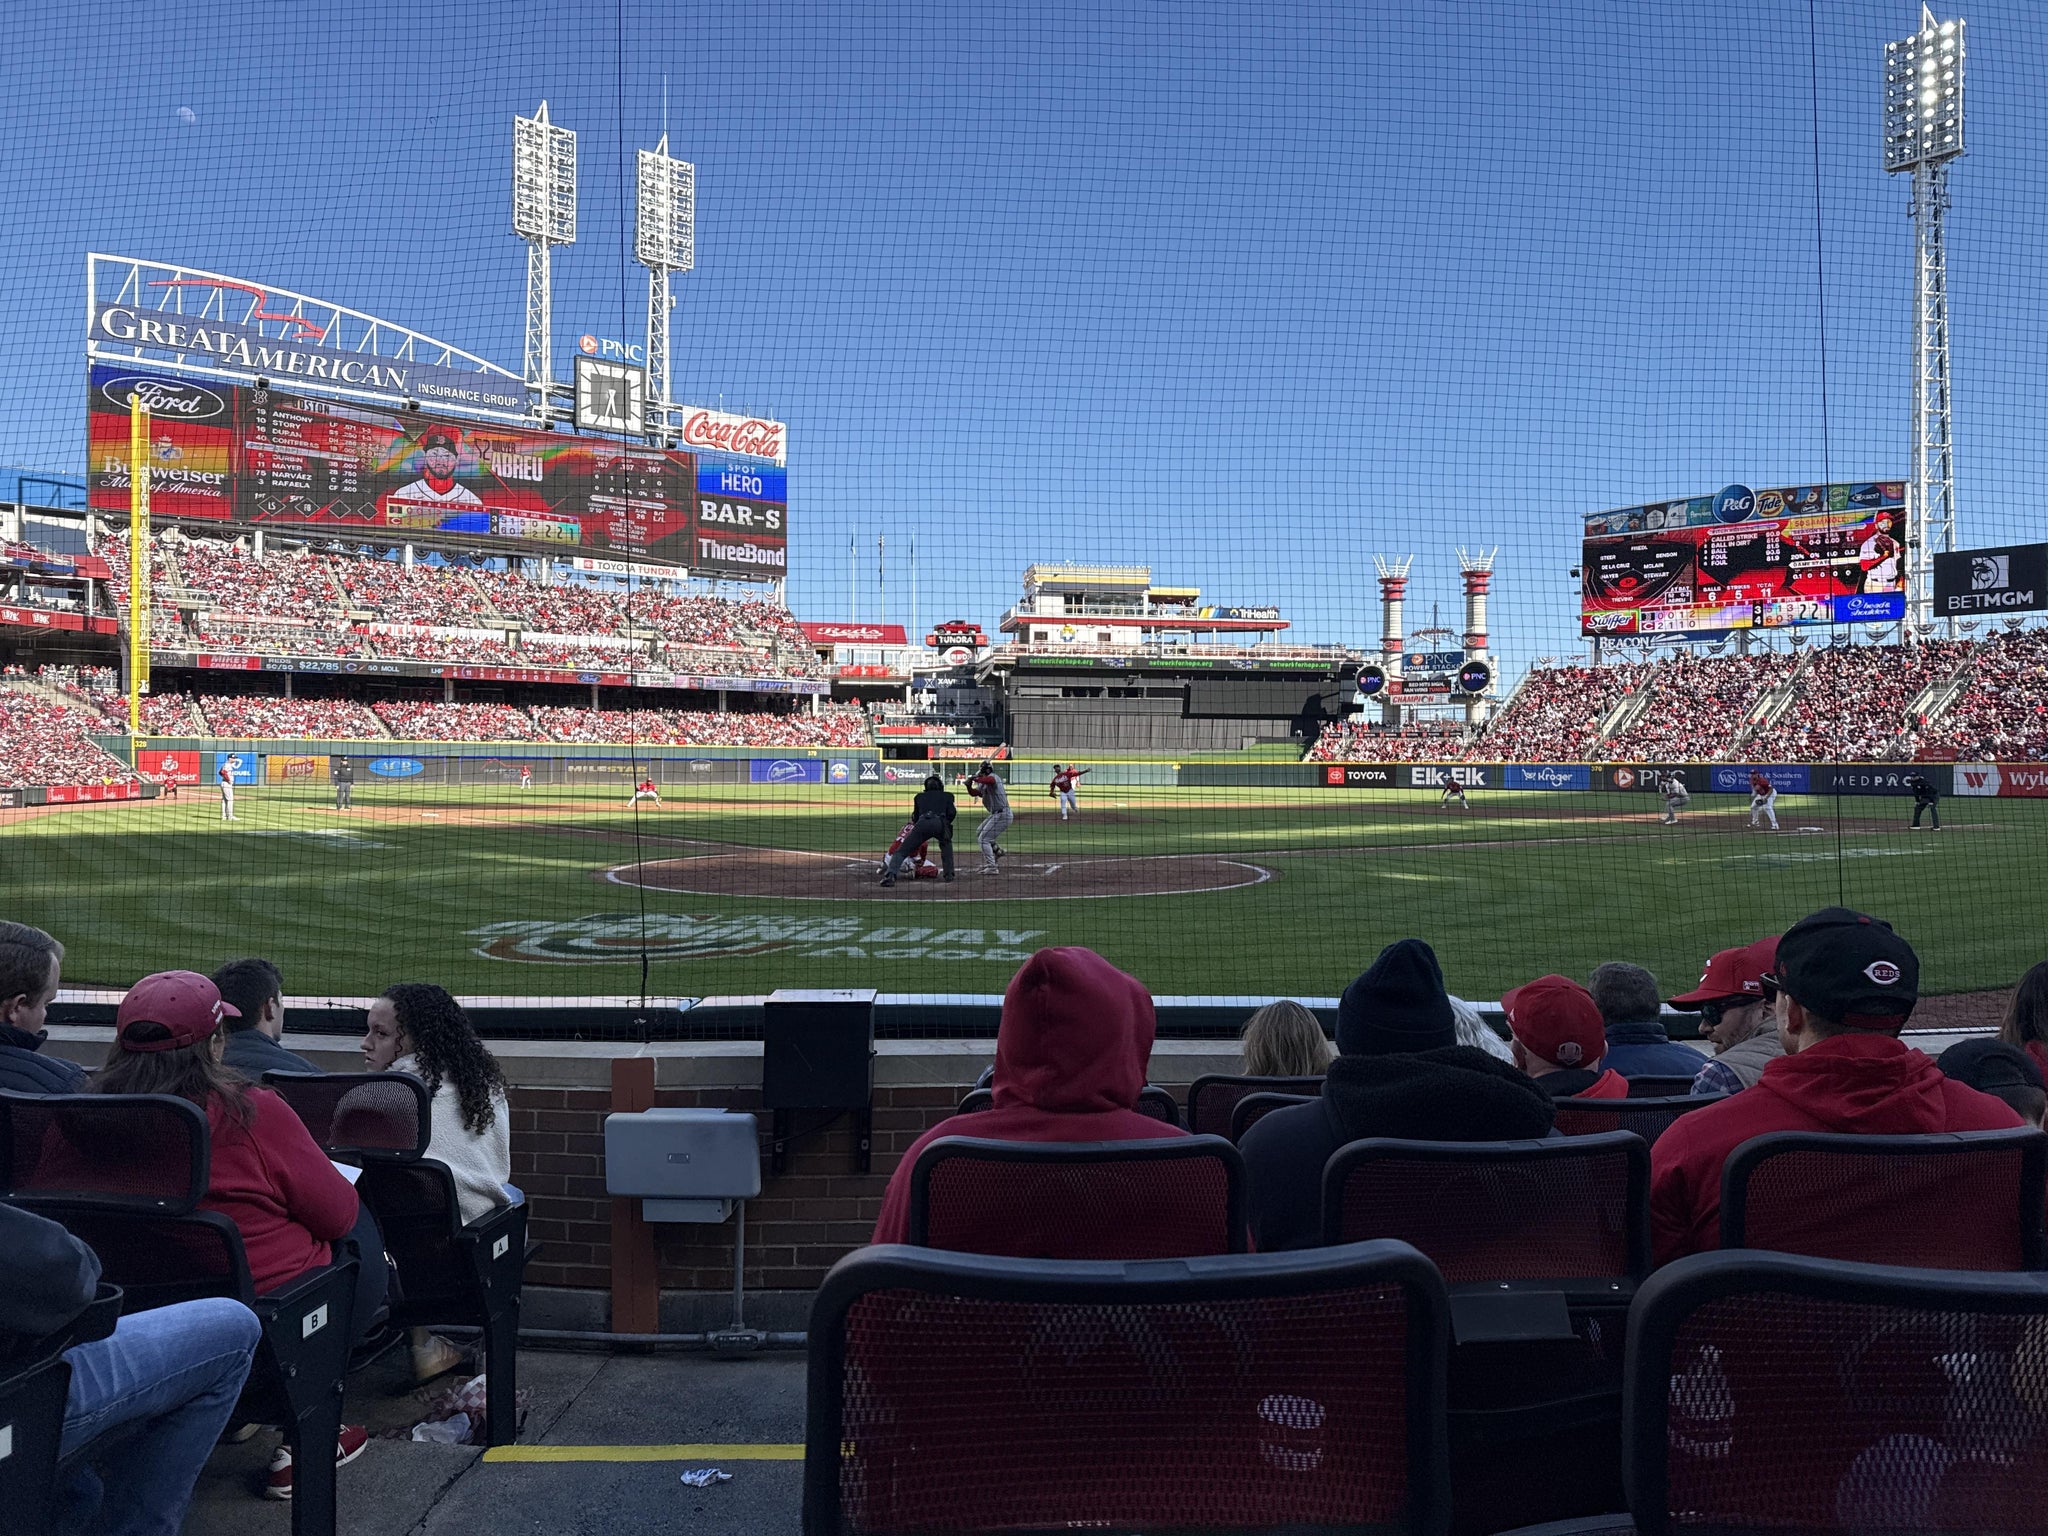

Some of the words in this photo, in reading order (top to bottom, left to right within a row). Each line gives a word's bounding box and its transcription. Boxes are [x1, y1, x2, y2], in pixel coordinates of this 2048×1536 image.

[600, 338, 643, 362] PNC
[126, 381, 202, 414] Ford
[417, 382, 480, 402] INSURANCE
[482, 391, 519, 407] GROUP
[272, 411, 313, 423] ANTHONY
[272, 419, 301, 430] STORY
[272, 428, 303, 438] DURAN
[102, 455, 225, 486] Buweiser
[272, 462, 303, 472] MAYER
[491, 451, 544, 482] ABREU
[727, 463, 756, 474] SPOT
[162, 481, 223, 498] America
[272, 480, 311, 490] RAFAELA
[721, 472, 763, 496] HERO
[1721, 496, 1752, 512] P&G
[1758, 497, 1782, 514] Tide
[700, 500, 781, 530] BAR-S
[1711, 535, 1736, 543] CALLED
[698, 538, 786, 567] ThreeBond
[1711, 547, 1728, 555] BALL
[597, 561, 636, 574] TOYOTA
[638, 565, 678, 578] TUNDRA
[1708, 591, 1717, 601] 6
[1735, 590, 1743, 599] 5
[1760, 588, 1772, 598] 11
[1948, 590, 2034, 610] BETMGM
[1754, 606, 1762, 614] 3
[1863, 601, 1885, 609] head
[1239, 609, 1279, 619] TriHealth
[1668, 612, 1675, 620] 0
[1689, 610, 1696, 618] 2
[1800, 604, 1807, 620] 2
[1811, 603, 1818, 620] 2
[1850, 608, 1891, 617] shoulders
[1587, 612, 1634, 630] Swiffer
[1657, 622, 1664, 630] 2
[1689, 620, 1696, 628] 0
[1754, 615, 1762, 625] 4
[816, 627, 884, 638] Reds
[938, 635, 974, 645] TUNDRA
[1600, 636, 1651, 649] BEACON
[211, 656, 249, 664] MIKES
[1029, 658, 1094, 666] networkforhope.org
[1148, 660, 1213, 668] networkforhope.org
[1424, 654, 1454, 664] PNC
[299, 661, 339, 671] $22,785
[380, 665, 400, 673] MOLL
[1270, 662, 1332, 670] networkforhope.org
[286, 762, 315, 774] Lay's
[568, 765, 647, 773] MILESTAR
[141, 769, 197, 782] Budweiser
[1347, 772, 1387, 780] TOYOTA
[1538, 768, 1573, 786] Kroger
[1832, 773, 1912, 788] MEDPAC
[460, 920, 863, 942] OPENING
[859, 926, 1051, 945] DAY
[798, 945, 1035, 961] Adob
[1873, 969, 1901, 979] REDS
[498, 1242, 504, 1254] A
[311, 1314, 319, 1329] B
